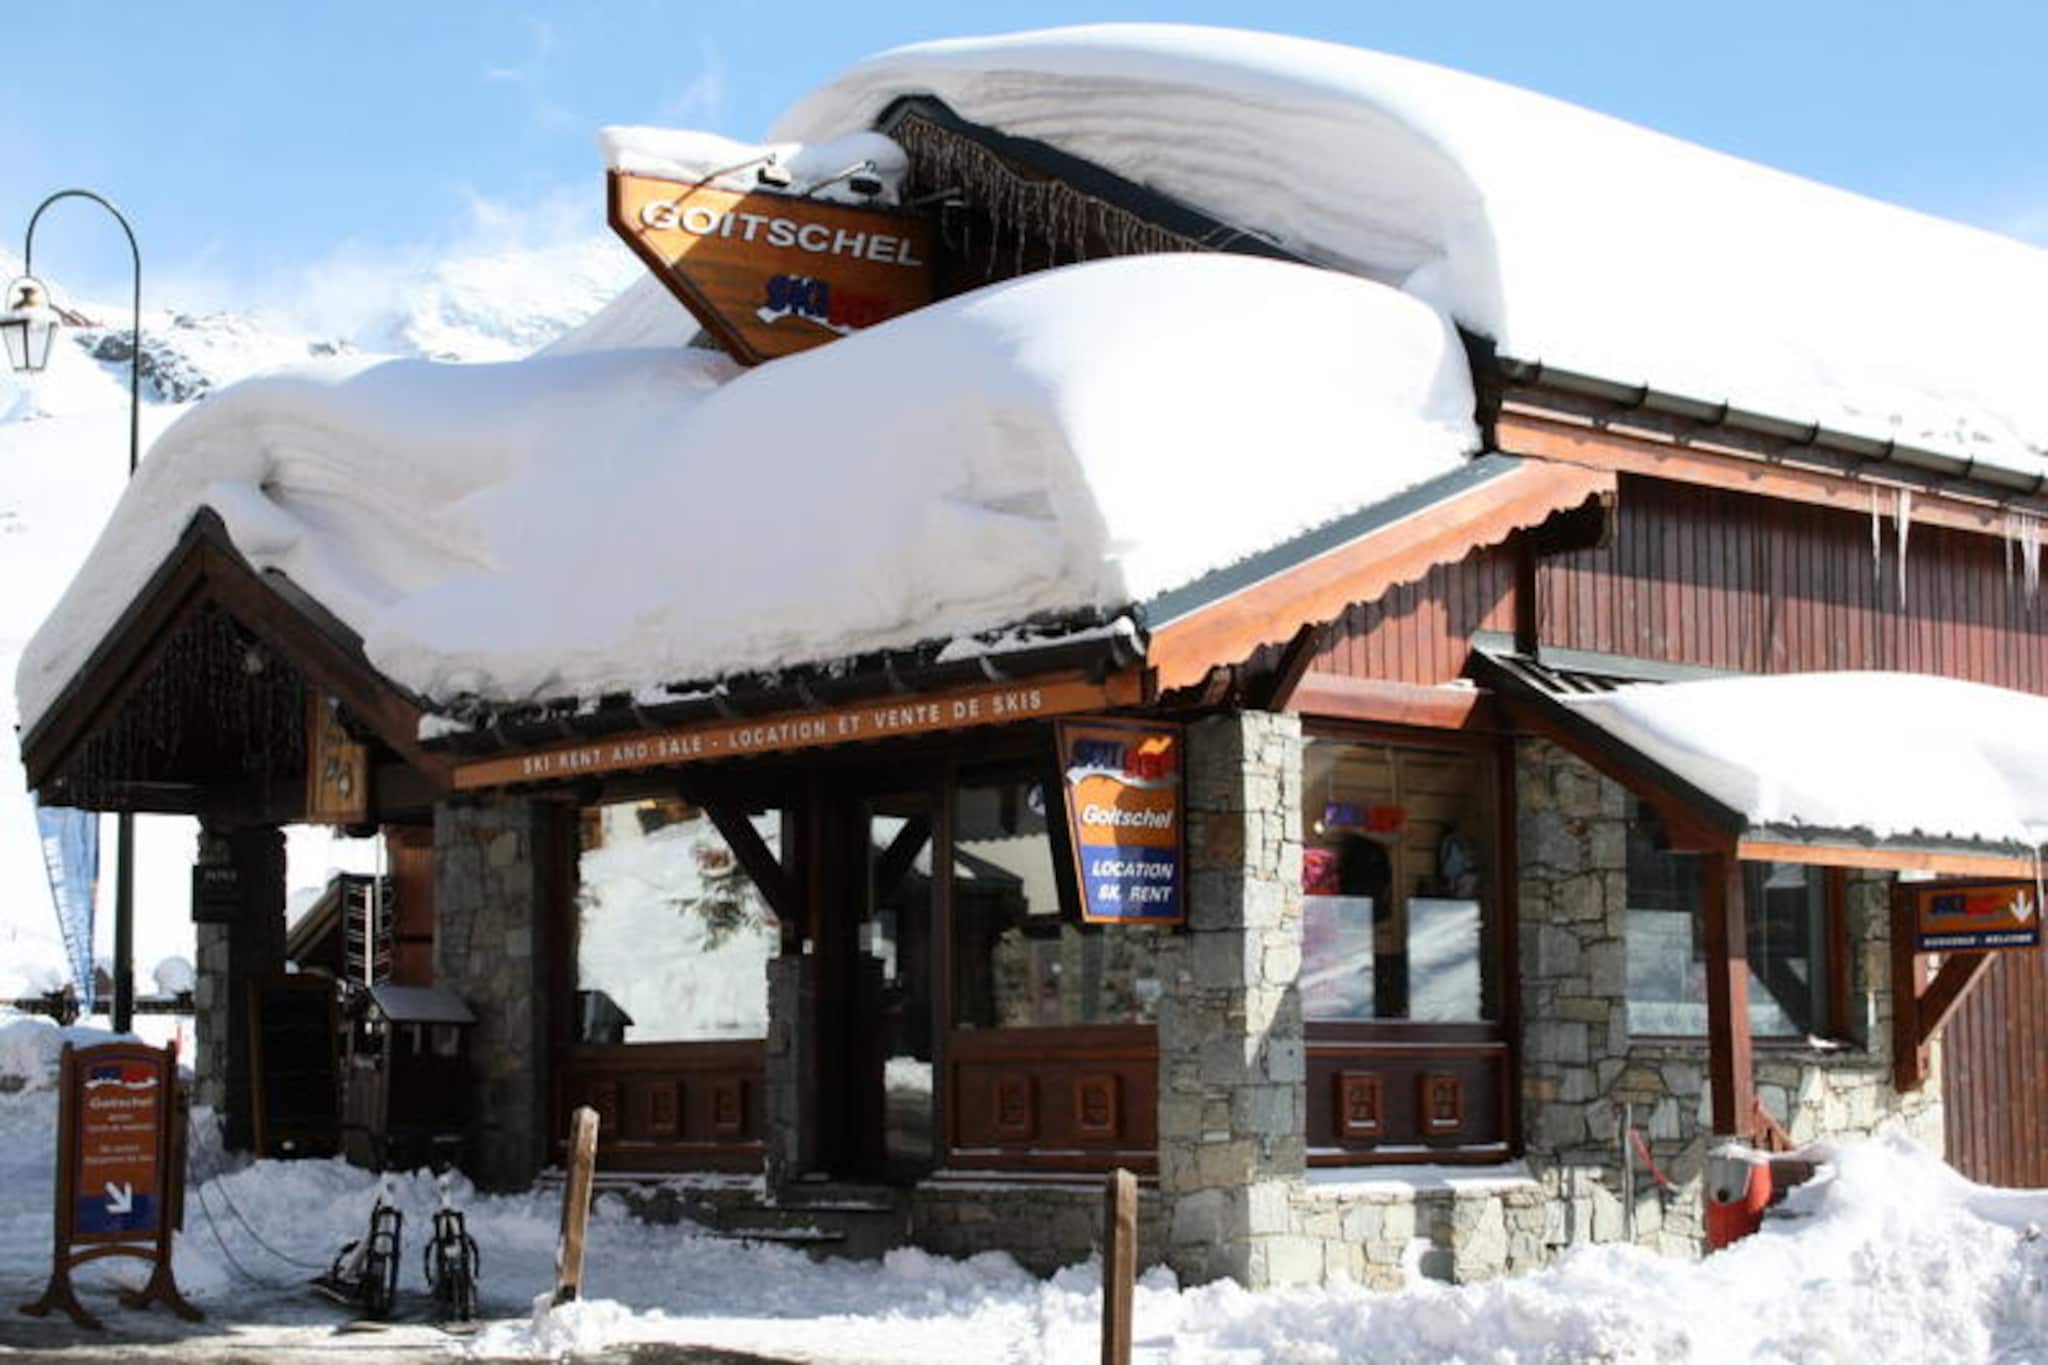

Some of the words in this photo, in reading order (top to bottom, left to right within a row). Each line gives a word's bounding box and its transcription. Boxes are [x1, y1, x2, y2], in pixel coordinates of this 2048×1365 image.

[641, 200, 923, 266] GOITSCHEL
[523, 756, 549, 774] SKI
[559, 750, 601, 769] RENT
[611, 743, 649, 762] AND
[655, 735, 702, 756] SALE
[729, 719, 825, 748] LOCATION
[838, 713, 861, 735] ET
[874, 704, 941, 729] VENTE
[953, 698, 980, 719] DE
[992, 690, 1041, 714] SKIS
[1082, 803, 1174, 829] Goitschel
[1092, 860, 1174, 880] LOCATION
[1128, 885, 1172, 902] RENT
